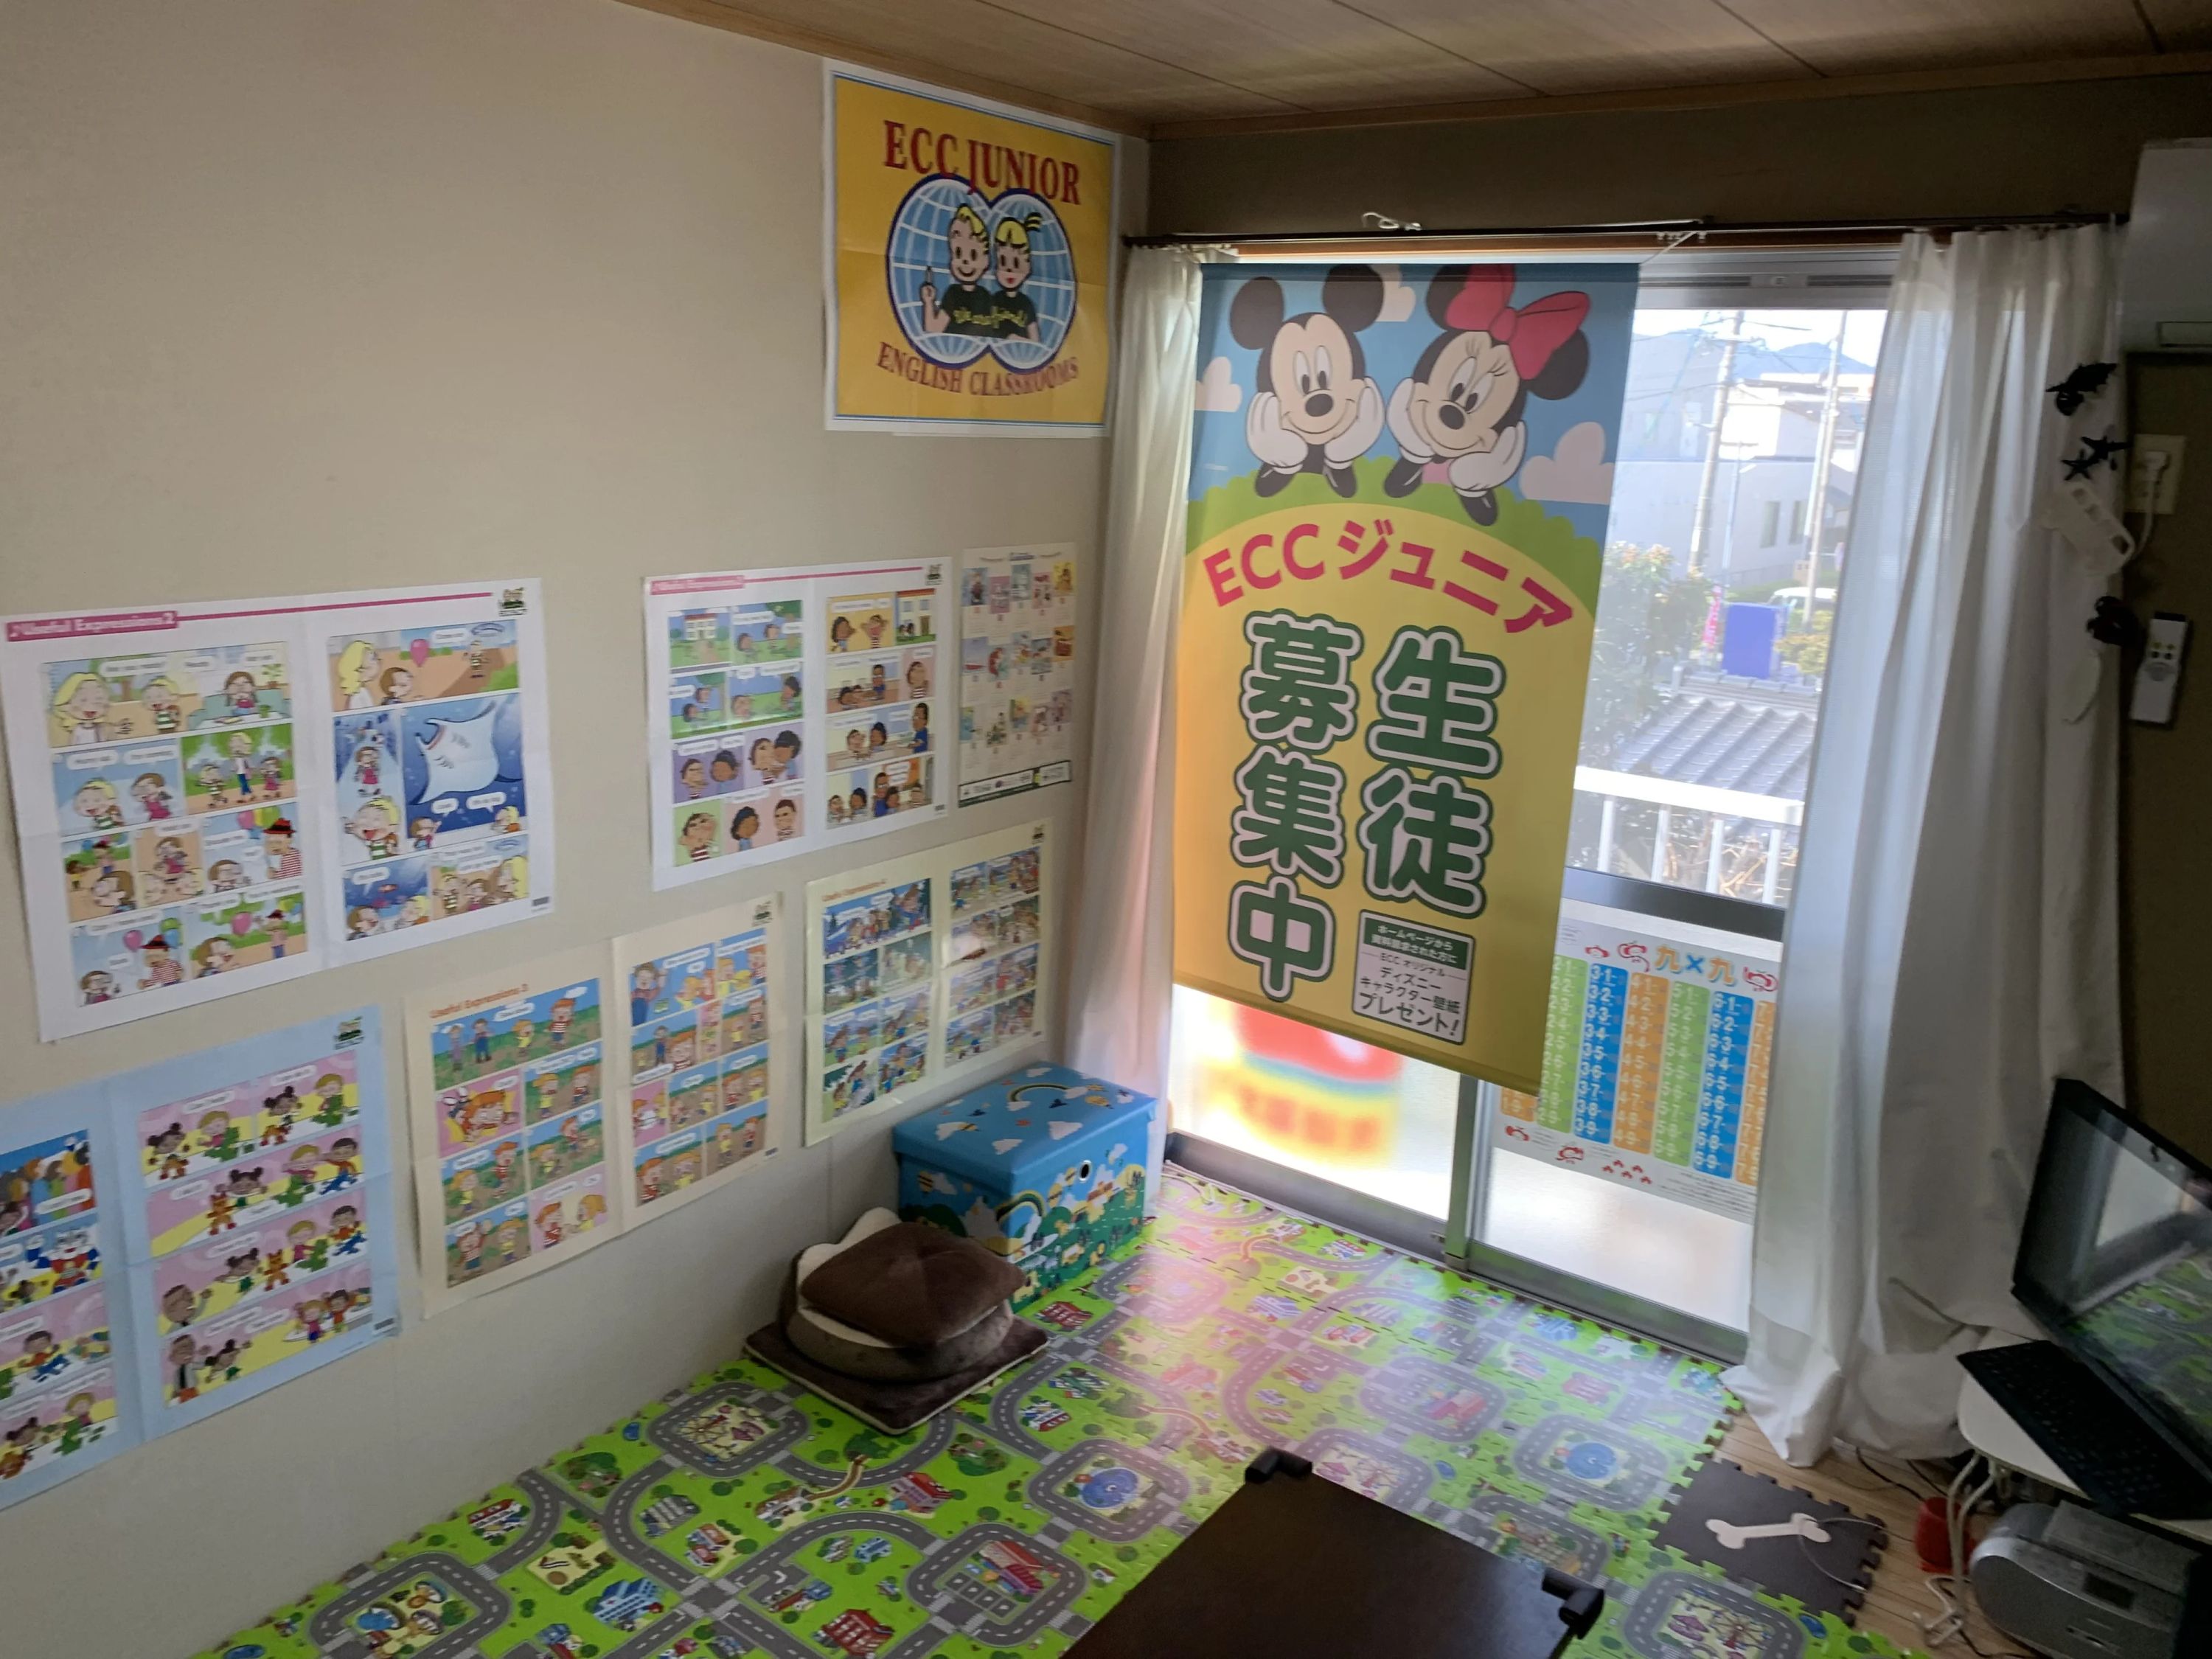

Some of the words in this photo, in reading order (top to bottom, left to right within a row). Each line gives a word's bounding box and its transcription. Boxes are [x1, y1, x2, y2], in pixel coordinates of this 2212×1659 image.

[884, 120, 959, 178] ECC
[967, 139, 1081, 205] JUNIOR
[877, 341, 961, 393] ENGLISH
[970, 357, 1079, 396] CLASSROOMS
[1357, 625, 1506, 919] 生徒
[1229, 608, 1363, 1001] 募集中
[1378, 925, 1453, 950] ホームページから
[1360, 975, 1461, 1014] キャラクター壁紙
[1380, 967, 1442, 990] ディズニー
[1360, 992, 1460, 1036] プレゼント!
